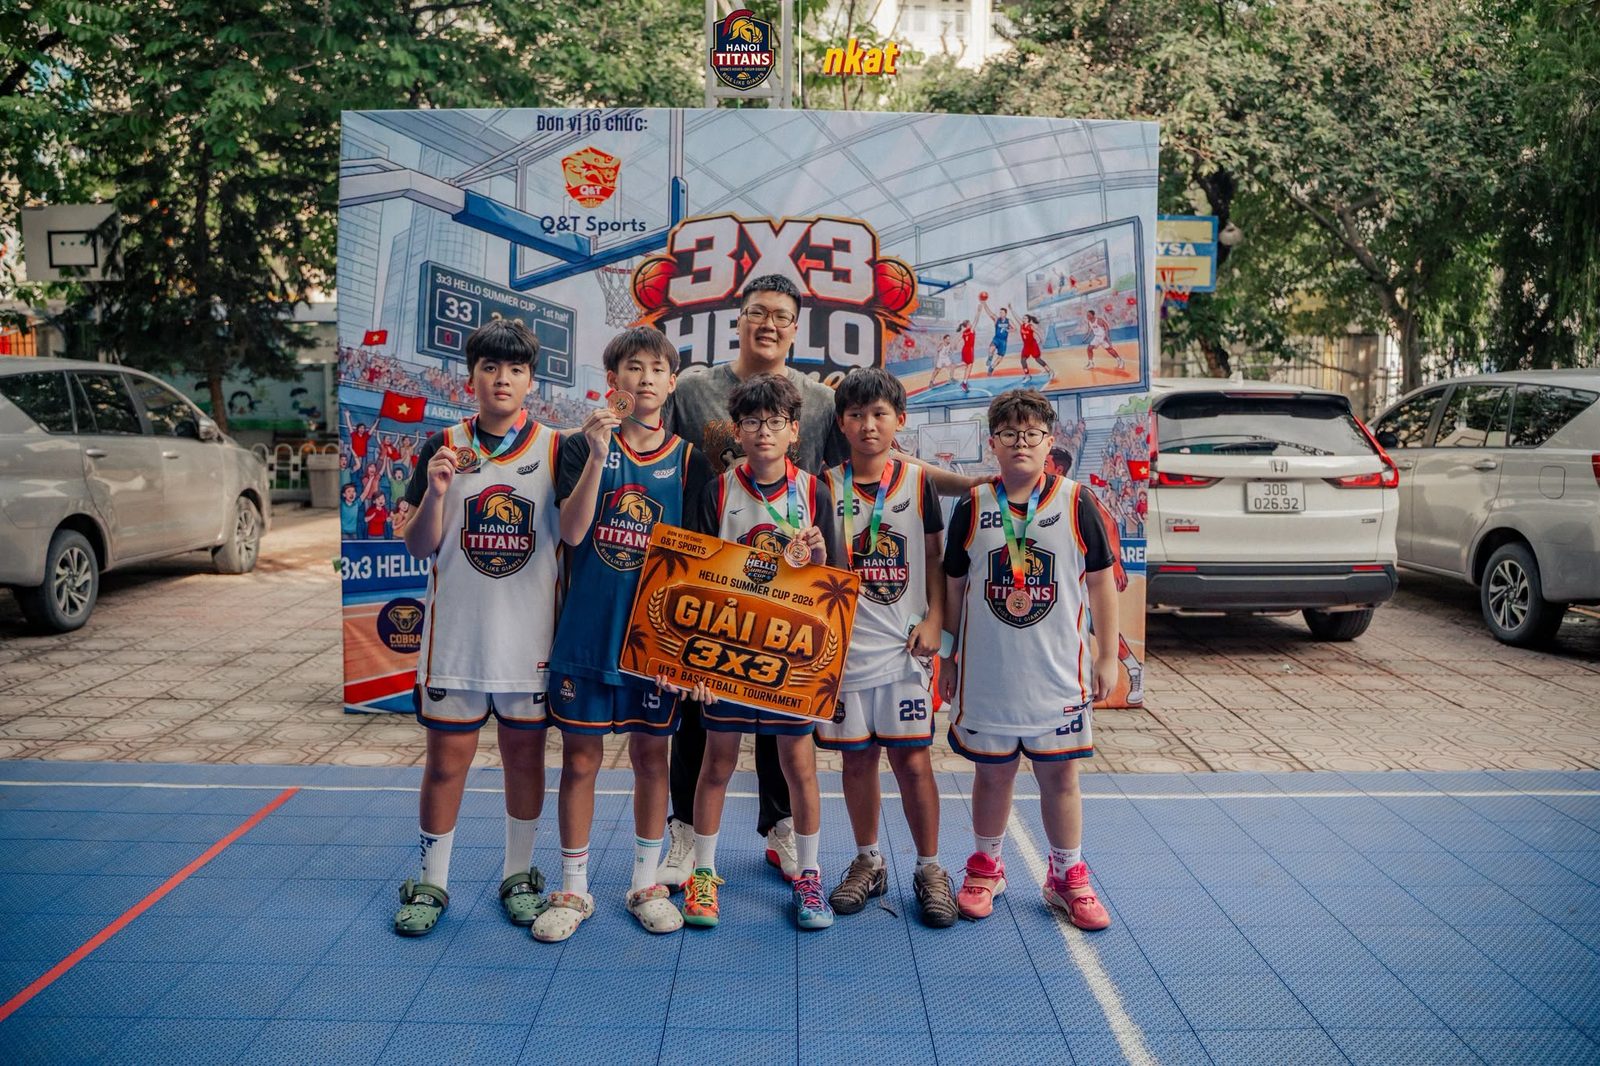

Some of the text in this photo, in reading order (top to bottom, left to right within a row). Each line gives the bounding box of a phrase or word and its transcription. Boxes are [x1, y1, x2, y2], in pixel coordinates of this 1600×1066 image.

[537, 115, 564, 131] Đơn
[540, 216, 647, 235] Q&T Sports
[436, 272, 452, 286] 3x3
[453, 279, 481, 296] HELLO
[482, 287, 519, 308] SUMMER
[519, 299, 537, 313] CUP
[543, 307, 554, 319] 1st
[445, 297, 473, 322] 33
[664, 306, 877, 370] HELO
[1264, 483, 1288, 496] 30B
[1254, 498, 1299, 510] 026.92
[610, 517, 648, 533] HANOI
[980, 511, 1003, 529] 28
[479, 523, 519, 534] HANOI
[468, 534, 529, 550] TITANS
[677, 540, 707, 556] SPORTS
[340, 555, 372, 580] 3x3
[485, 564, 499, 572] LIKE
[501, 558, 523, 571] GIANTS
[610, 558, 624, 567] LIKE
[746, 558, 777, 572] HELLO
[863, 558, 897, 567] HANOI
[699, 569, 814, 607] HELLO SUMMER CUP 2026
[674, 594, 813, 657] GIẢI BA
[658, 663, 803, 708] U13 BASKETBALL TOURNAMENT
[899, 698, 927, 721] 25
